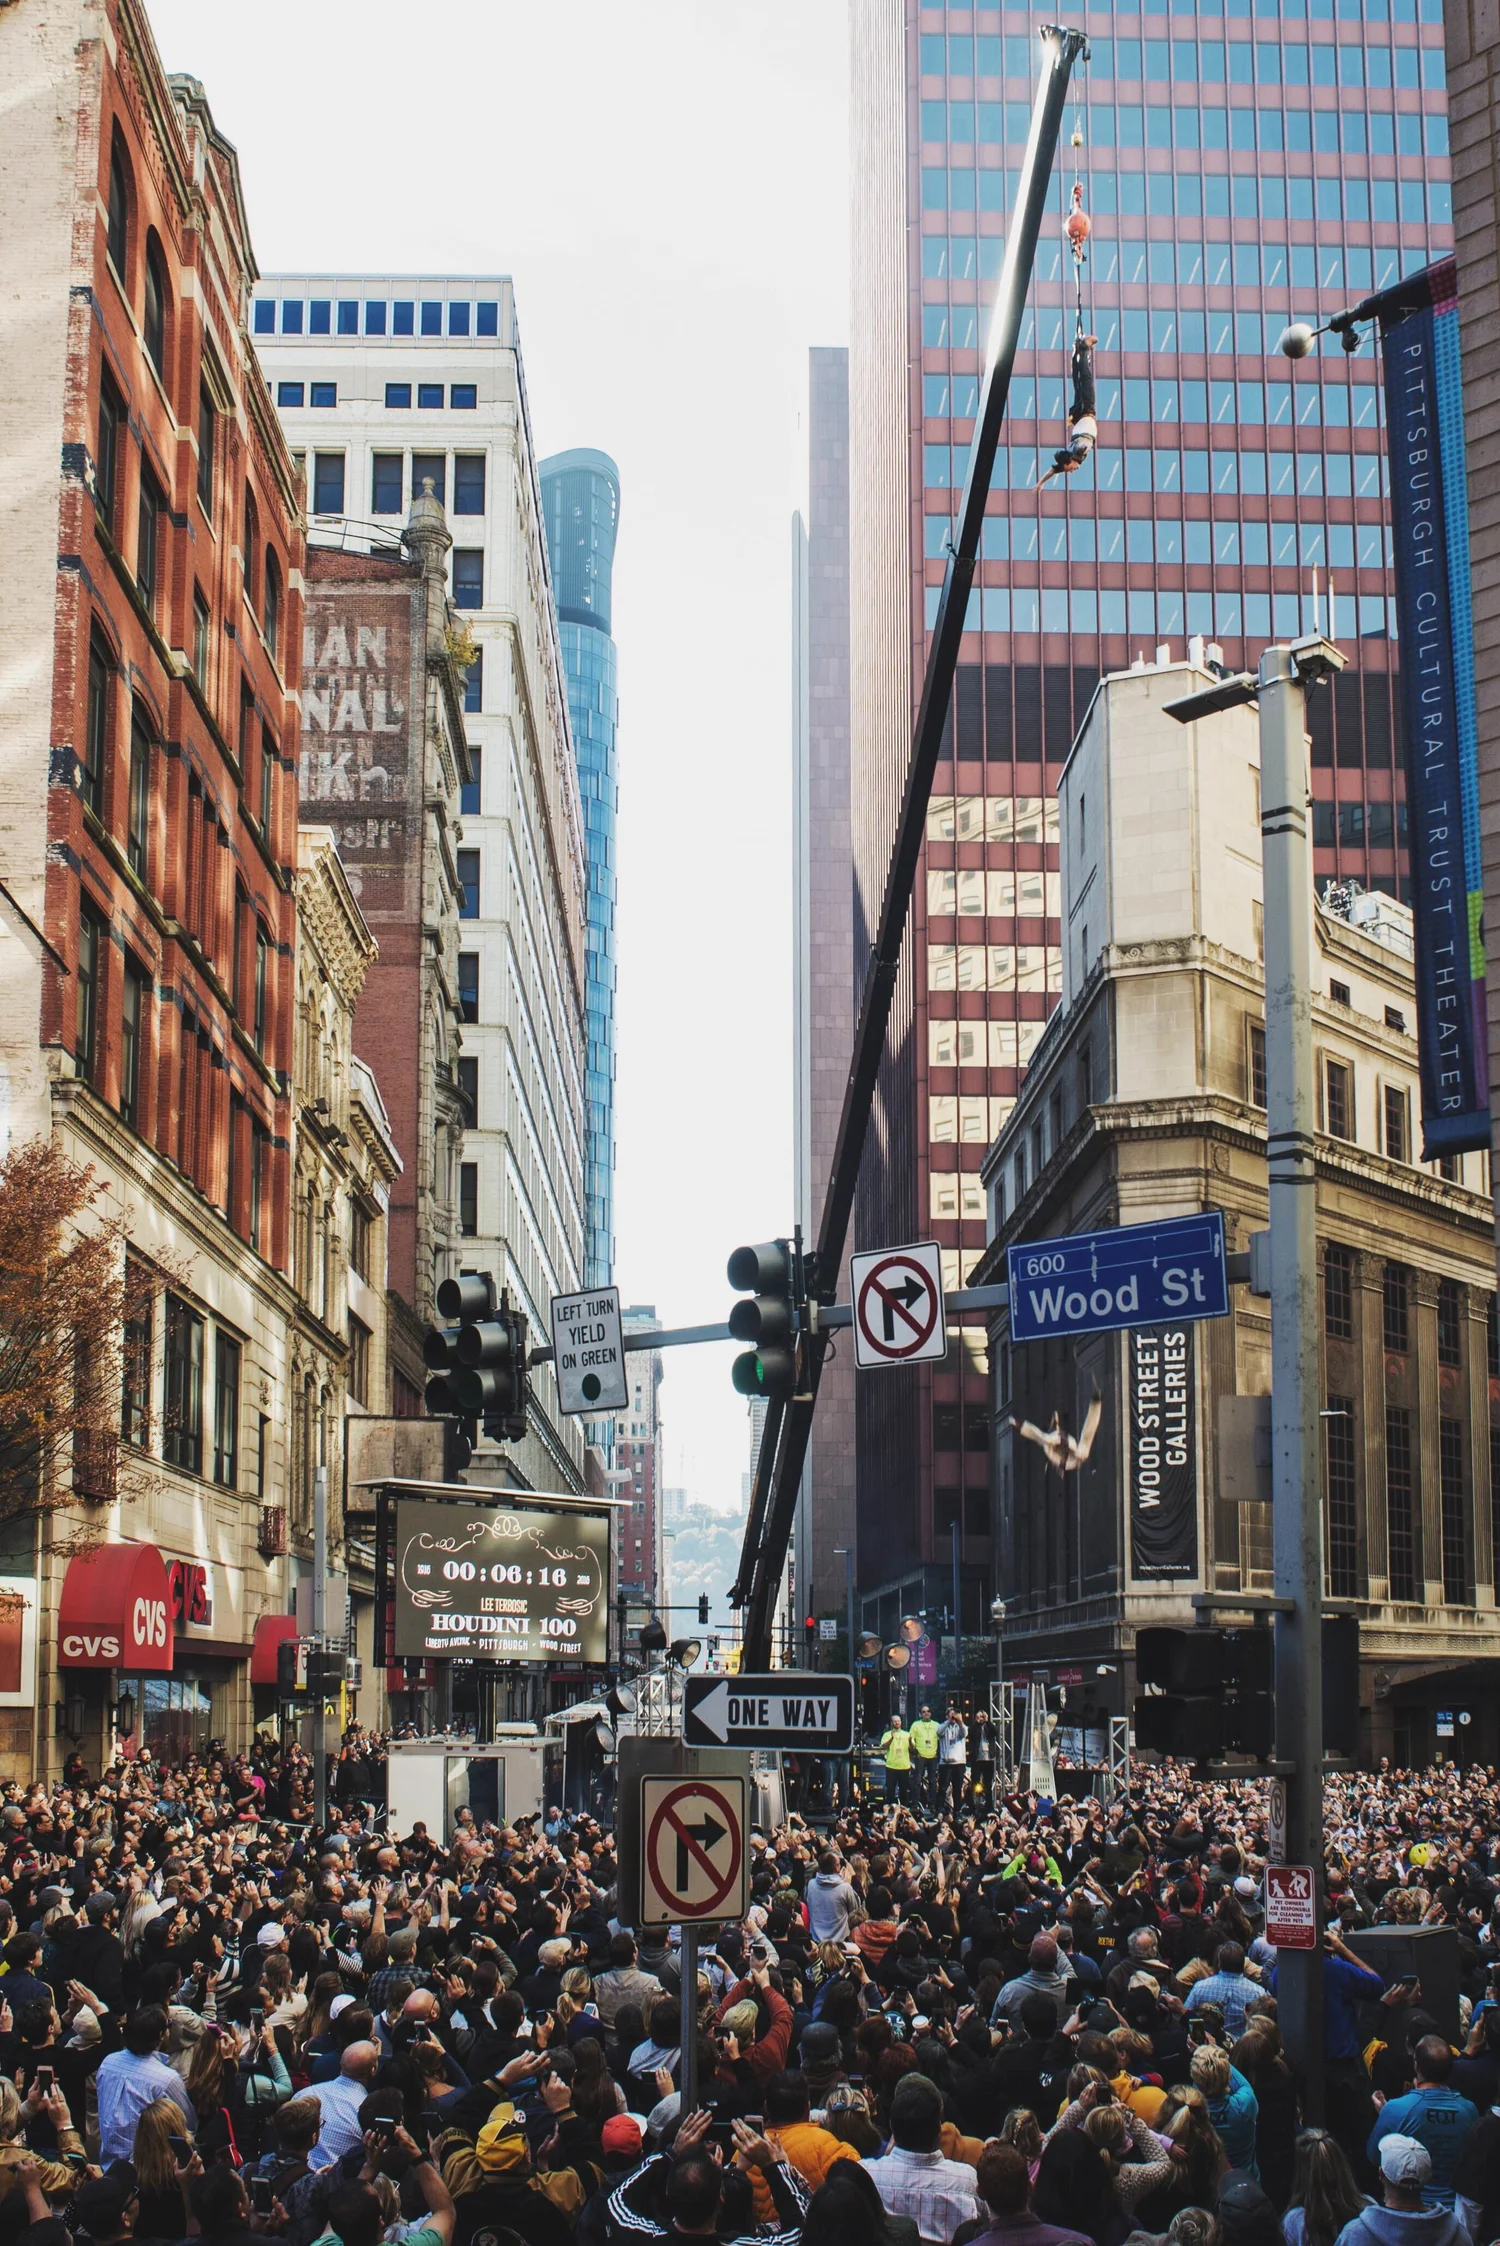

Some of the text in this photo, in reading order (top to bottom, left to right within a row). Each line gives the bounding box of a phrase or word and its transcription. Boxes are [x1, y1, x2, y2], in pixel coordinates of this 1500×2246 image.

[1402, 343, 1434, 568] PITTSBURGH
[1416, 591, 1445, 779] CULTURAL
[1427, 800, 1452, 914] TRUST
[1435, 940, 1462, 1112] THEATER
[1027, 1254, 1066, 1277] 600
[557, 1298, 614, 1322] LEFT TURN
[1028, 1267, 1206, 1324] Wood St
[568, 1323, 606, 1346] YIELD
[562, 1347, 617, 1370] ON GREEN
[1163, 1331, 1188, 1466] GALLERIES
[1137, 1334, 1160, 1510] WOOD STREET
[168, 1559, 207, 1623] CVS
[480, 1597, 528, 1614] LEE TERBOSIC
[133, 1597, 167, 1647] CVS
[431, 1613, 577, 1637] HOUDINI 100
[63, 1636, 120, 1658] CVS
[478, 1638, 528, 1651] PITTSBURGH
[540, 1639, 558, 1651] WOOD
[727, 1697, 831, 1728] ONE WAY
